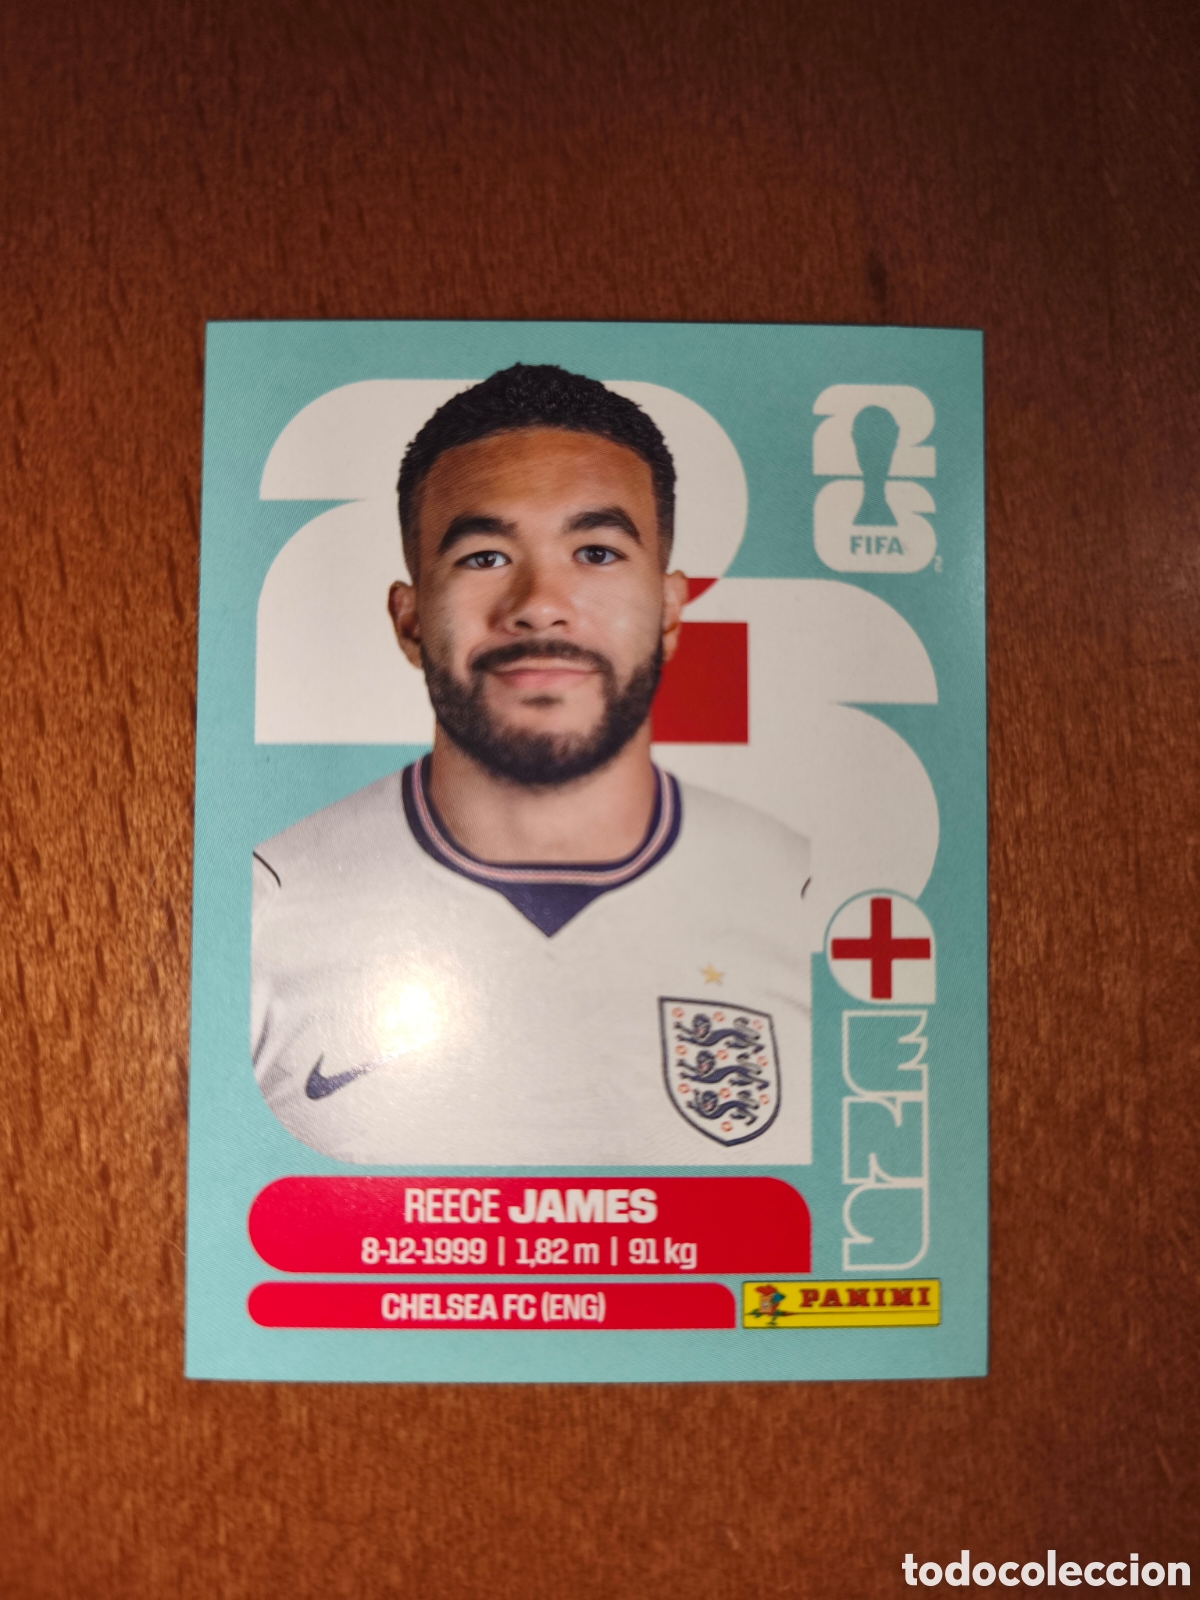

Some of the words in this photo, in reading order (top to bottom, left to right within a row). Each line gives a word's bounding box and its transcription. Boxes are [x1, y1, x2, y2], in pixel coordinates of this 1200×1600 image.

[850, 536, 904, 556] FIFA
[404, 1188, 501, 1223] REECE
[508, 1188, 658, 1223] JAMES
[361, 1236, 488, 1265] 8-12-1999
[515, 1236, 570, 1268] 1,82
[574, 1242, 601, 1264] m
[628, 1237, 660, 1264] 91
[664, 1237, 698, 1270] kg
[381, 1293, 499, 1321] CHELSEA
[503, 1293, 537, 1321] FC
[541, 1291, 607, 1323] (ENG)
[800, 1287, 932, 1309] PANINI
